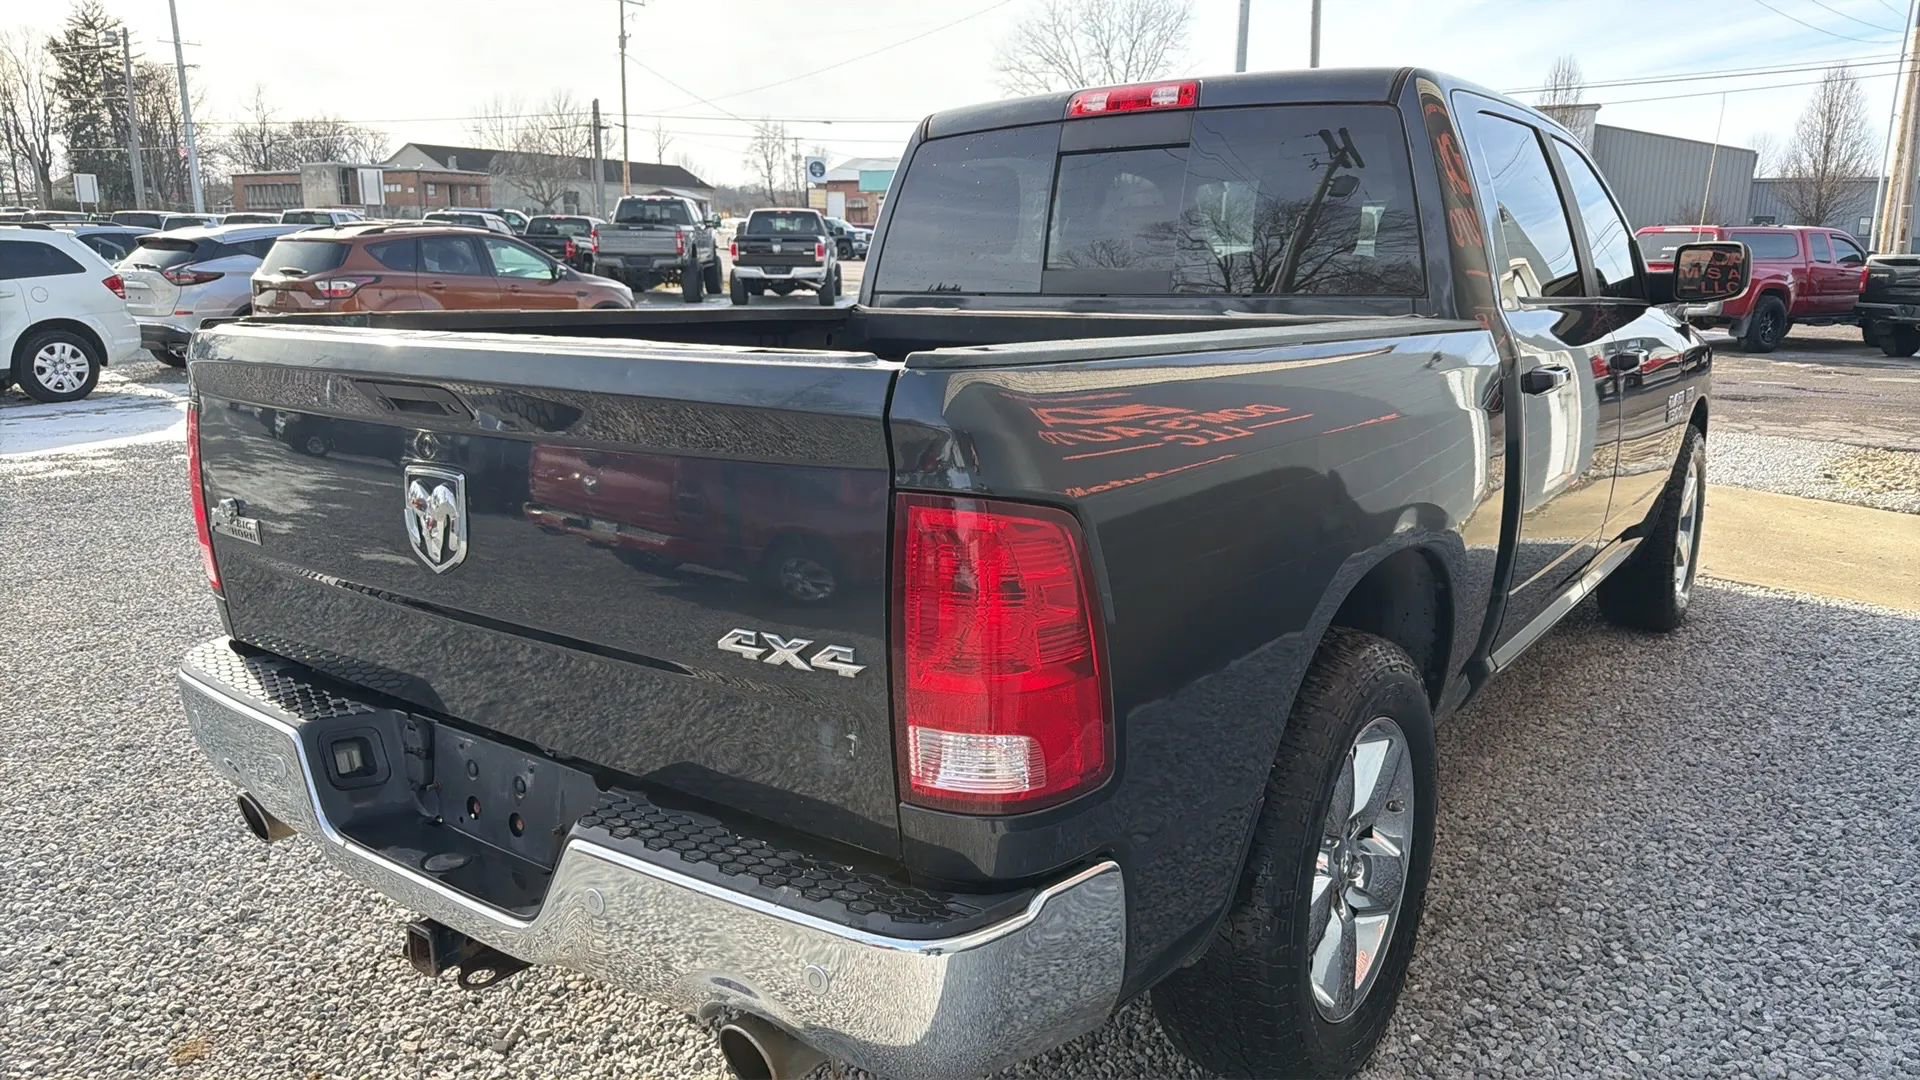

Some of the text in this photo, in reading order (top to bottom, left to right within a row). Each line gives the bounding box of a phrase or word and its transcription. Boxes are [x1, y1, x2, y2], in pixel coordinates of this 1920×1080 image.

[236, 519, 252, 530] BIG
[231, 527, 257, 541] HORN
[717, 628, 868, 678] 4X4
